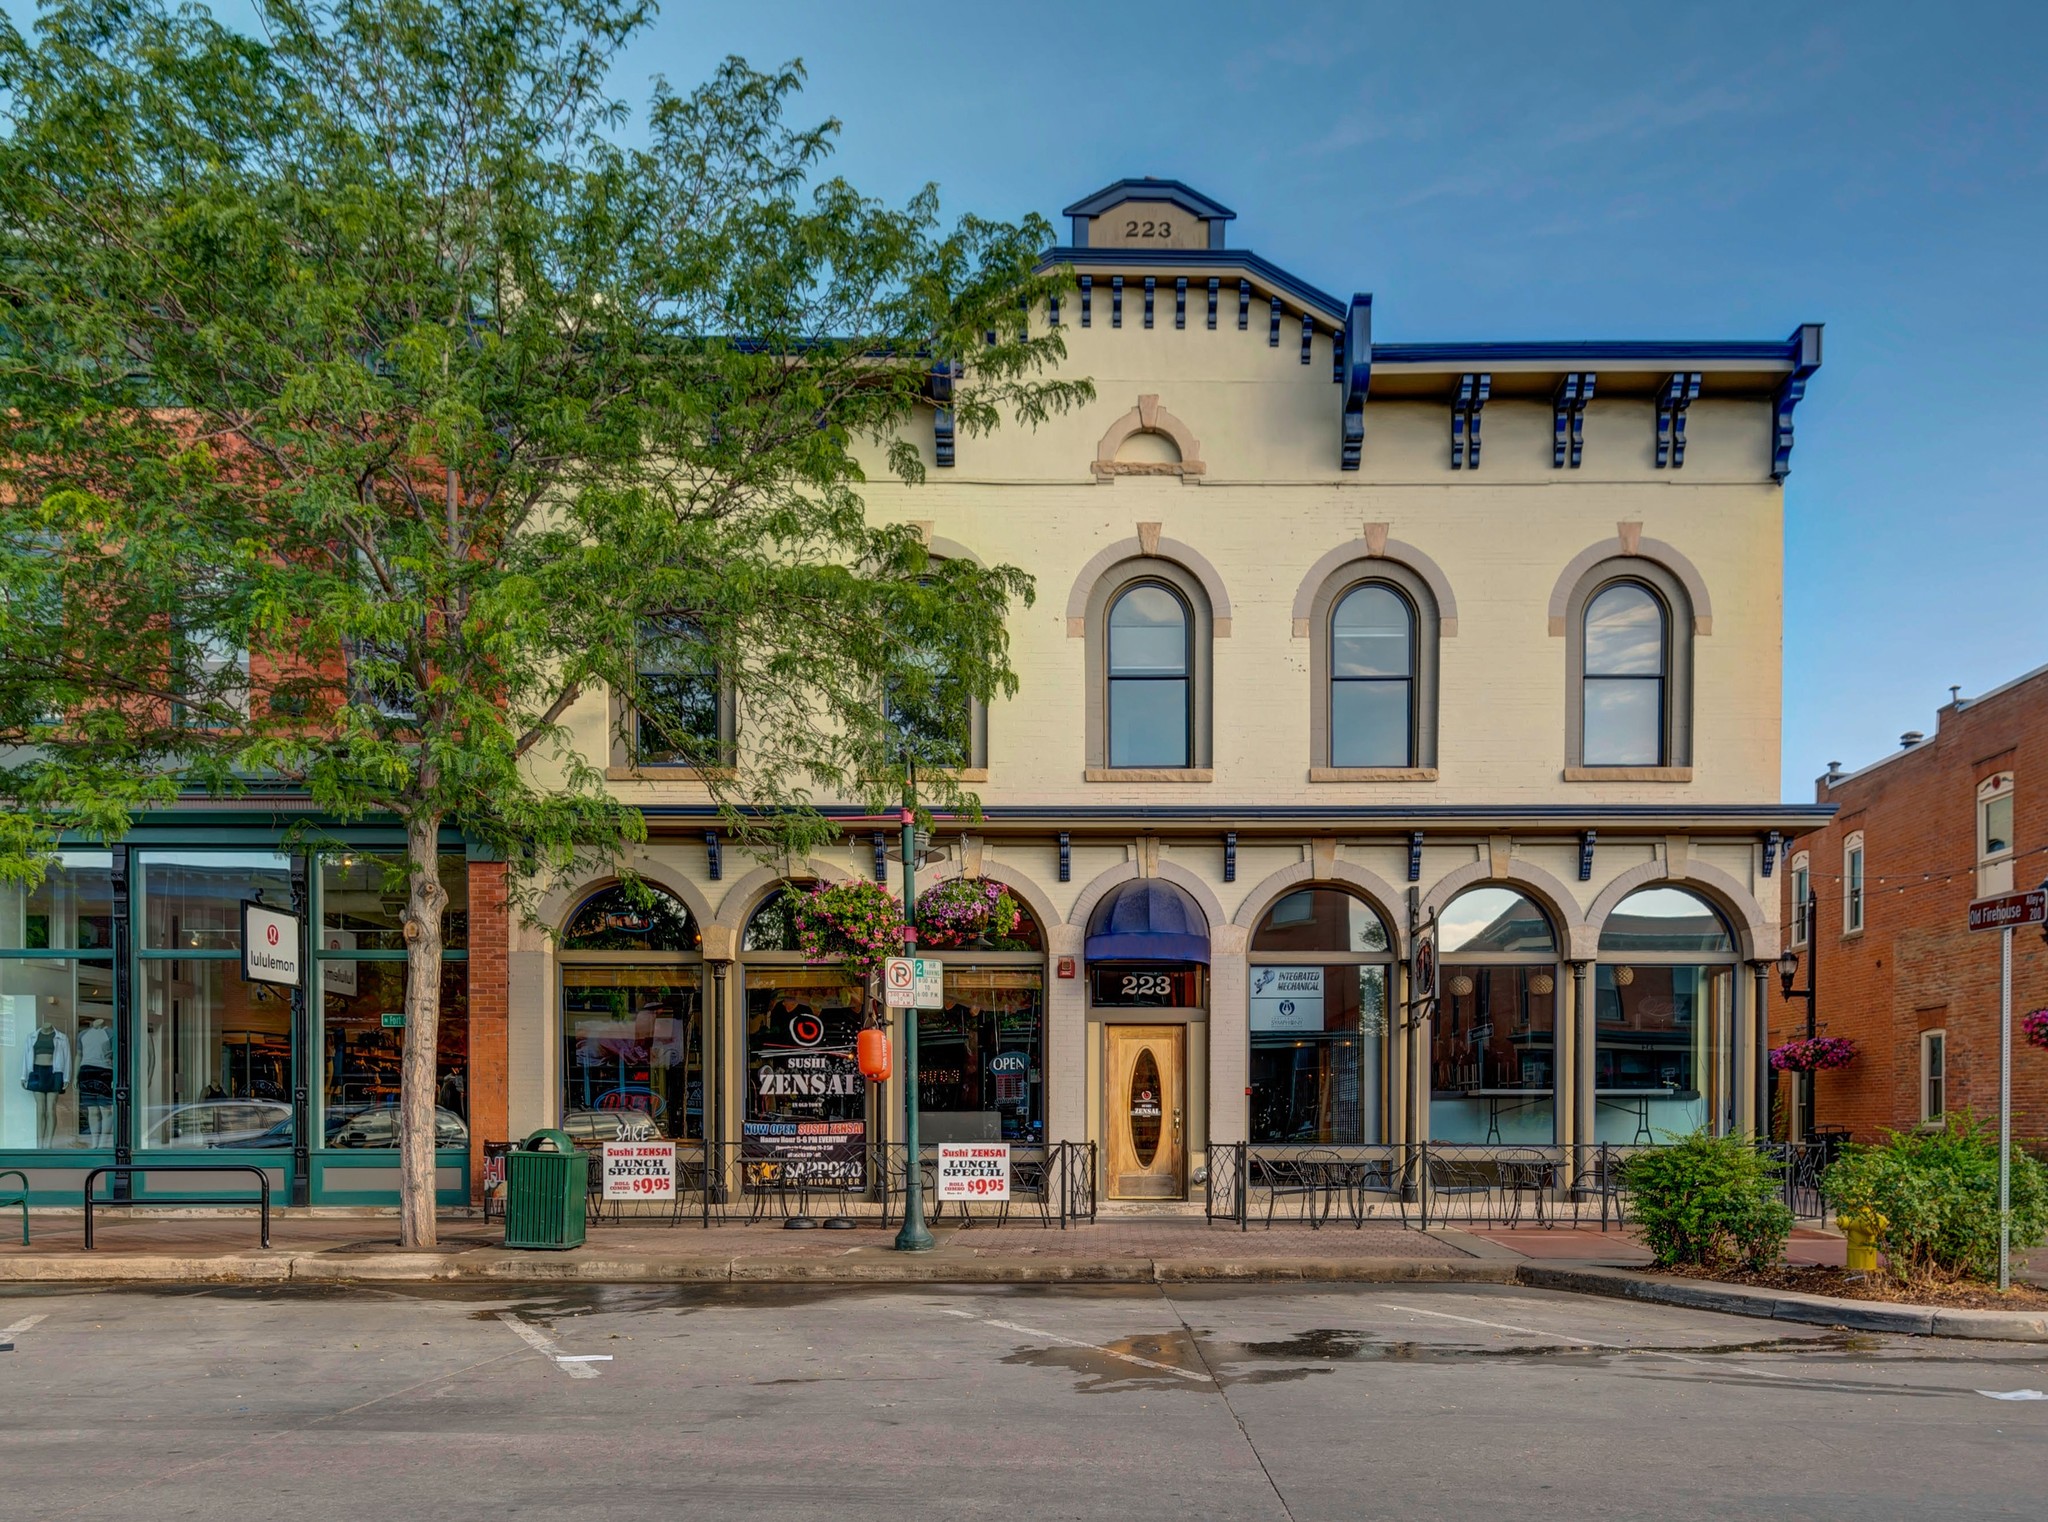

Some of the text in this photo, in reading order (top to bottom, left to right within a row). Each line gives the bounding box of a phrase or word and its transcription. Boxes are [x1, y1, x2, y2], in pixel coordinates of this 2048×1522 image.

[1125, 220, 1172, 239] 223
[2026, 894, 2039, 907] Alley
[1970, 905, 2021, 925] Old Firehouse
[2029, 907, 2042, 921] 200
[250, 950, 295, 973] lululemon
[916, 962, 923, 975] 2
[1278, 972, 1320, 981] INTEGRATED
[1121, 976, 1171, 995] 223
[1277, 982, 1320, 991] MECHANICAL
[389, 1015, 401, 1025] Fort
[788, 1058, 826, 1069] SUSHI
[993, 1057, 1025, 1070] OPEN
[759, 1074, 855, 1095] ZENSAI
[616, 1124, 649, 1141] SAKE
[744, 1122, 864, 1135] NOW OPEN SUSHI ZENSAI
[608, 1148, 672, 1156] Sushi ZENSAI
[943, 1149, 1006, 1157] Sushi ZENSAI
[608, 1168, 670, 1176] SPECIAL
[943, 1169, 1004, 1177] SPECIAL
[633, 1178, 670, 1194] $9.95
[968, 1179, 1004, 1195] $9.95
